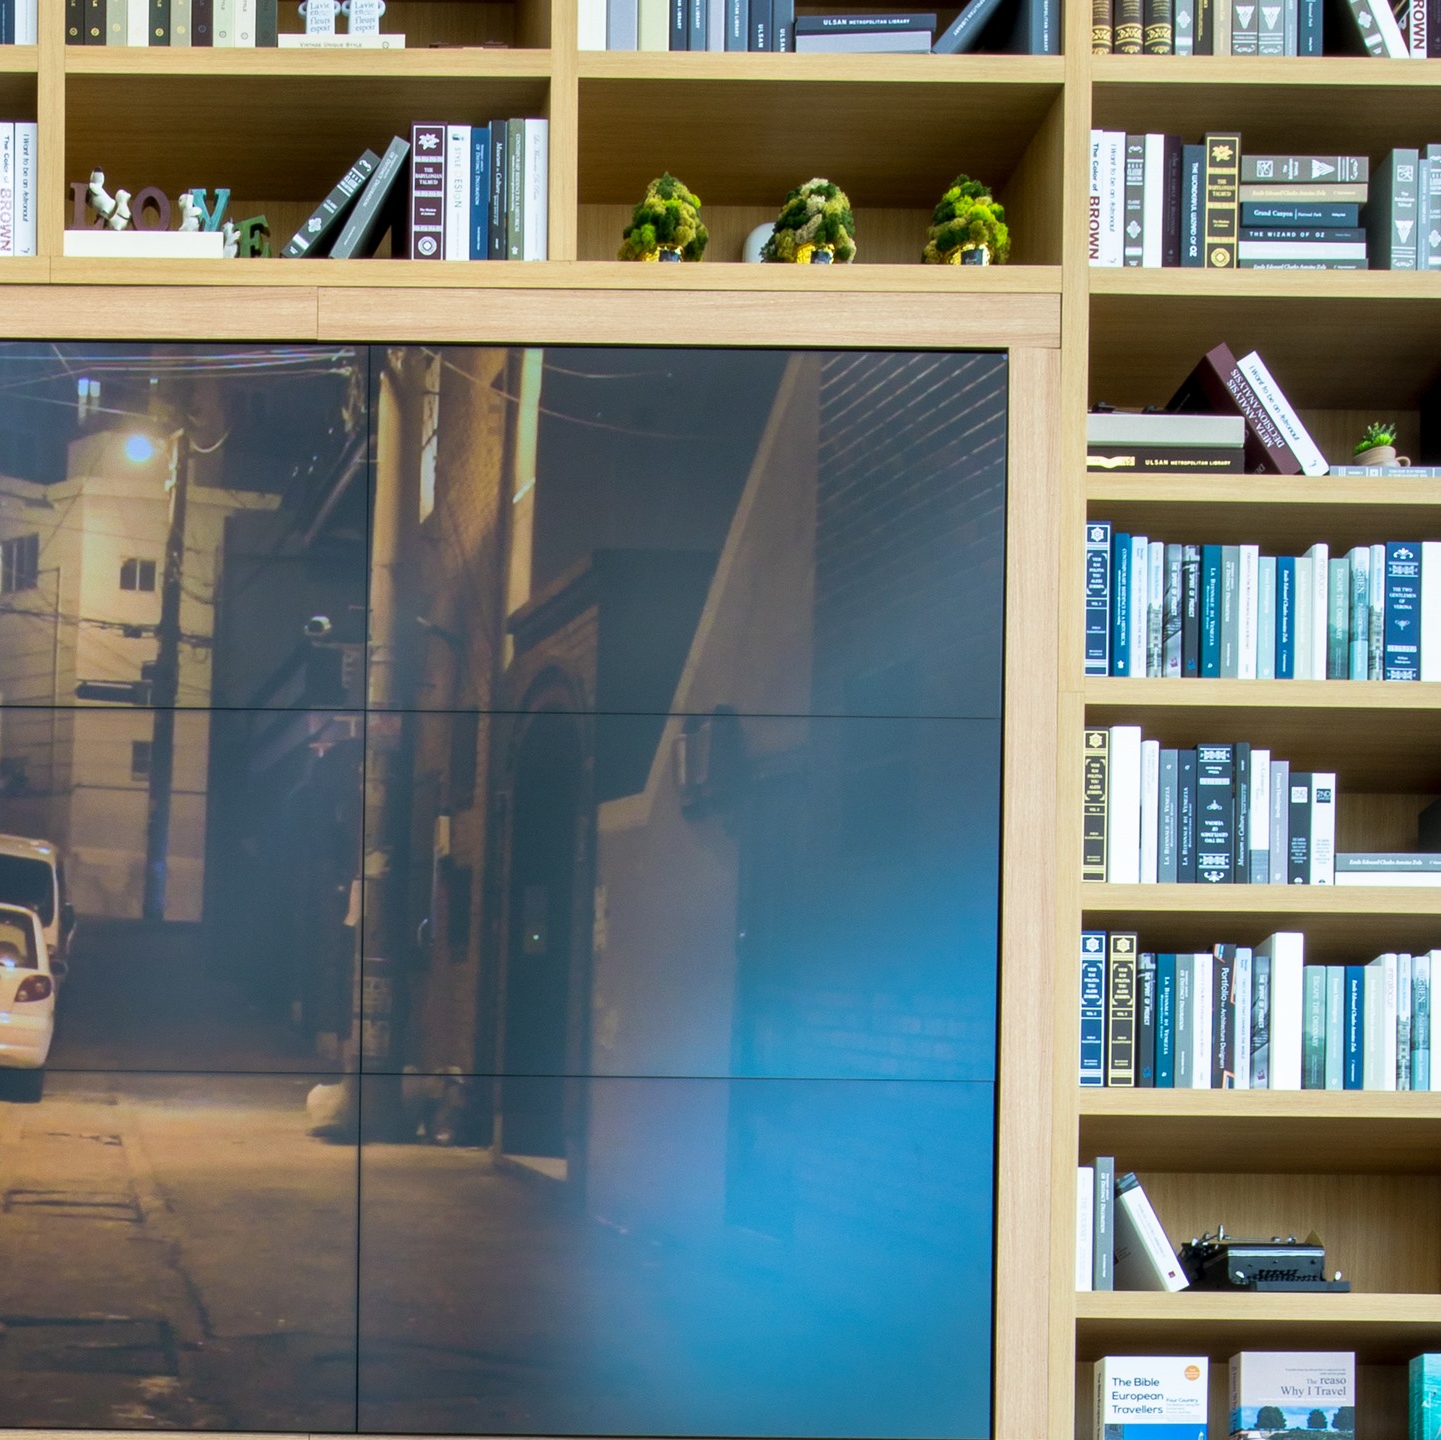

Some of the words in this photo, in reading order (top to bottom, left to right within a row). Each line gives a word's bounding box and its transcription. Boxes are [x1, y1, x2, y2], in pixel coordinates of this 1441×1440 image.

[1112, 1378, 1131, 1387] The
[1134, 1378, 1159, 1387] Bible
[1320, 1376, 1346, 1385] reaso
[1280, 1386, 1304, 1397] Why
[1307, 1386, 1312, 1396] I
[1315, 1386, 1346, 1396] Travel
[1112, 1392, 1164, 1402] European
[1112, 1405, 1163, 1414] Travellers
